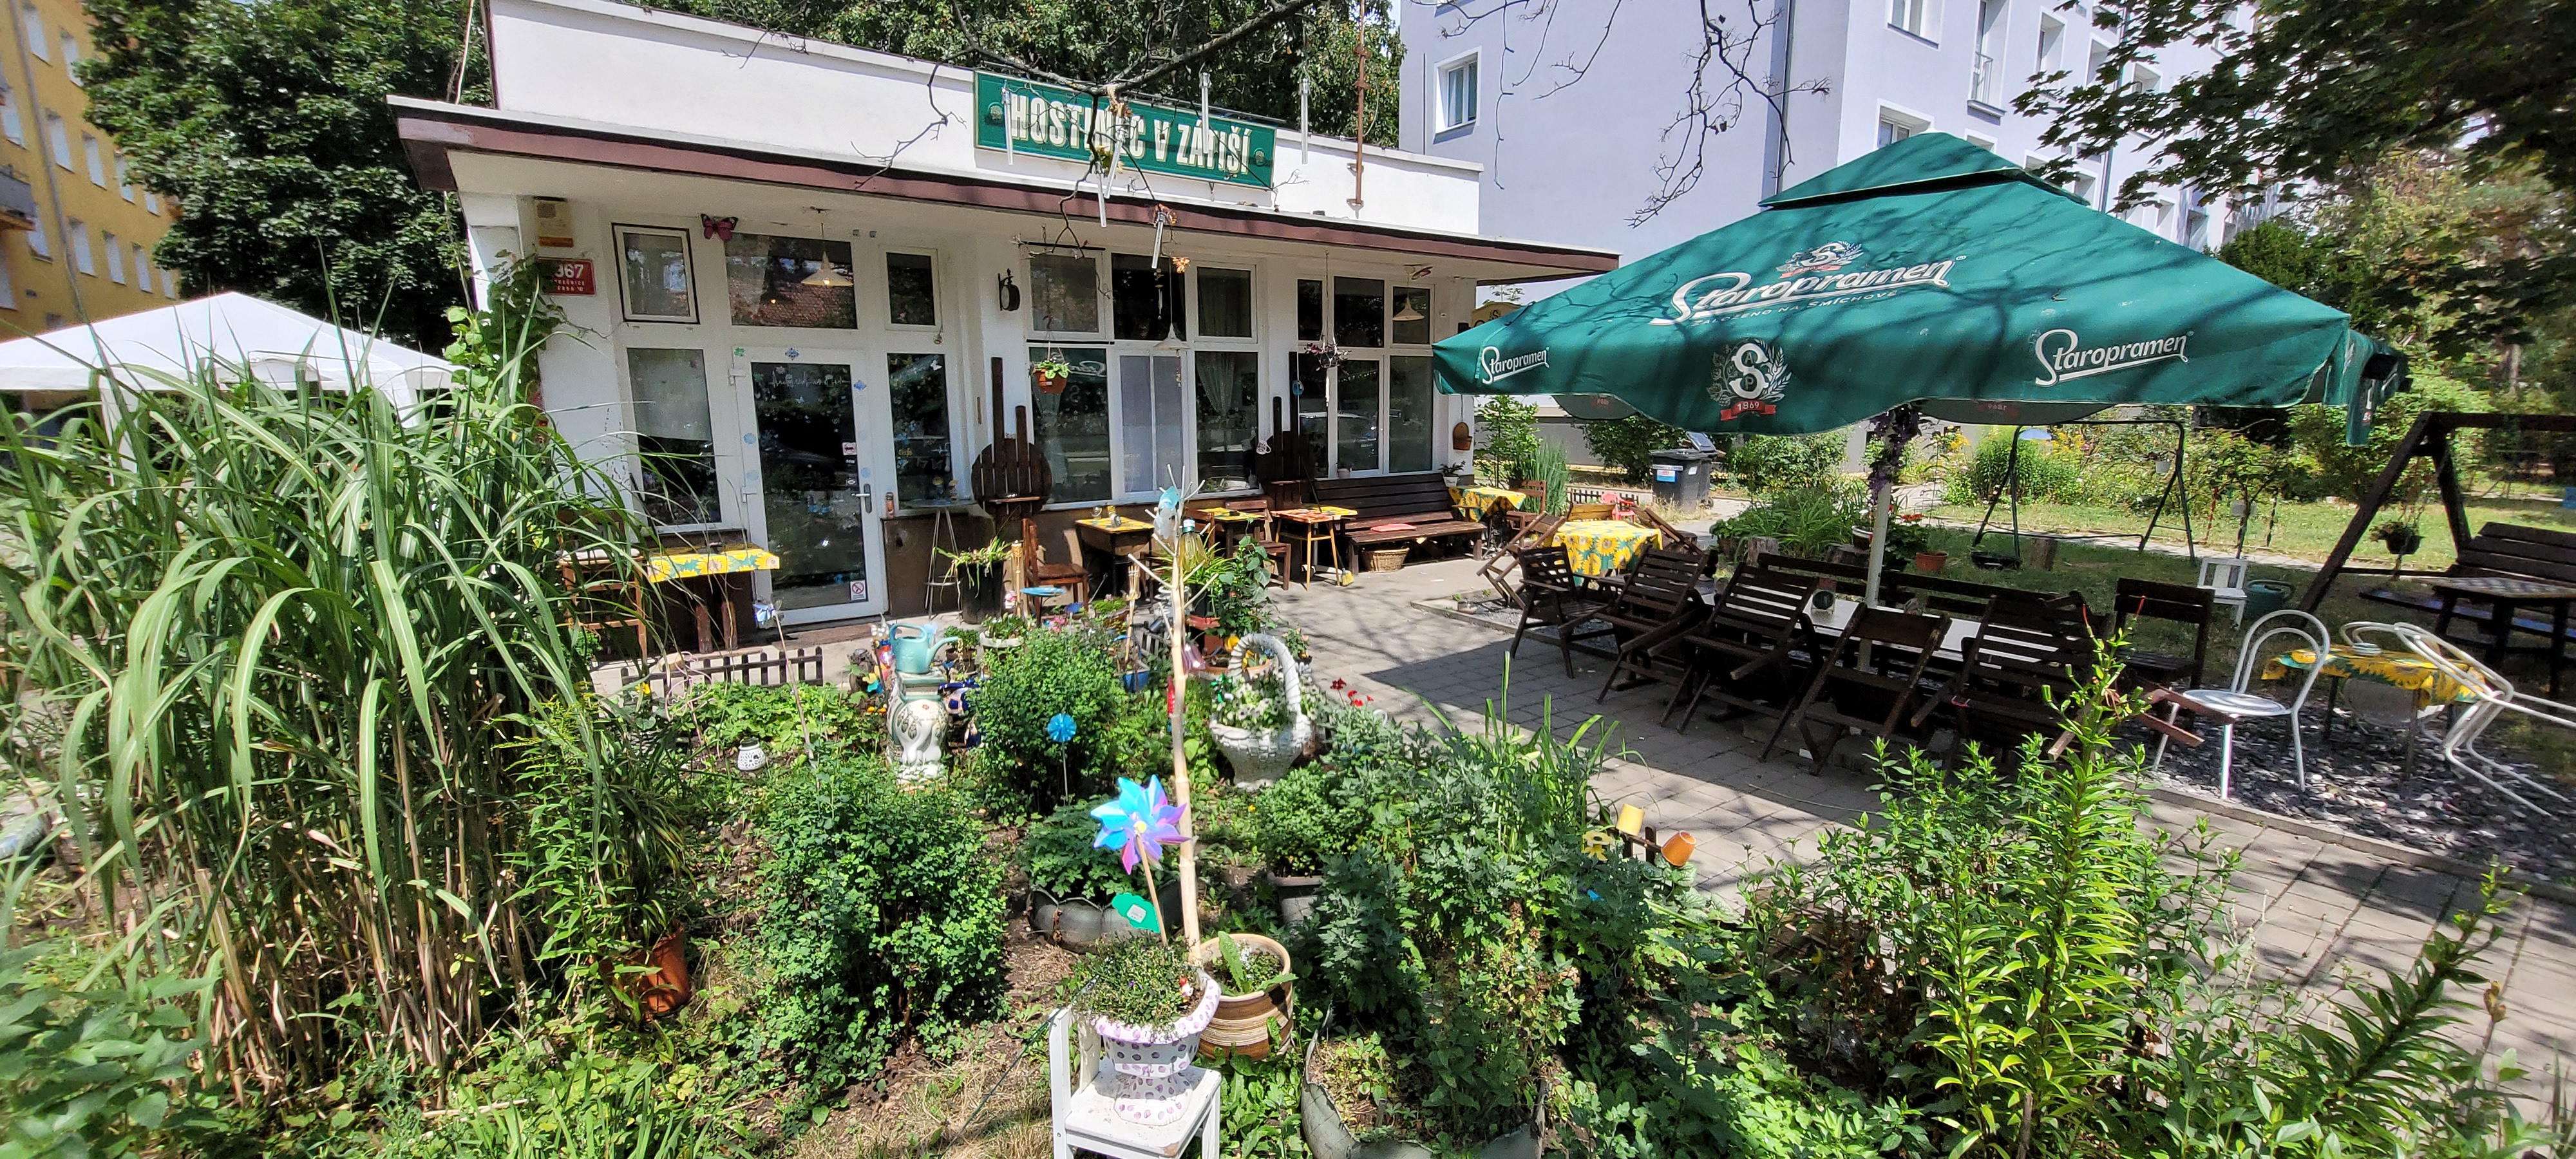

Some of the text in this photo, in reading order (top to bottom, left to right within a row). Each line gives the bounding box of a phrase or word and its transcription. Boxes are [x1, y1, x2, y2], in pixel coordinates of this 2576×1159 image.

[1154, 118, 1171, 162] V
[1177, 118, 1253, 175] ZÁTIŠÍ
[1650, 259, 1955, 326] Staropramen
[1481, 346, 1550, 385] Staropramen
[2034, 328, 2188, 386] Staropramen
[1737, 401, 1759, 411] 1869
